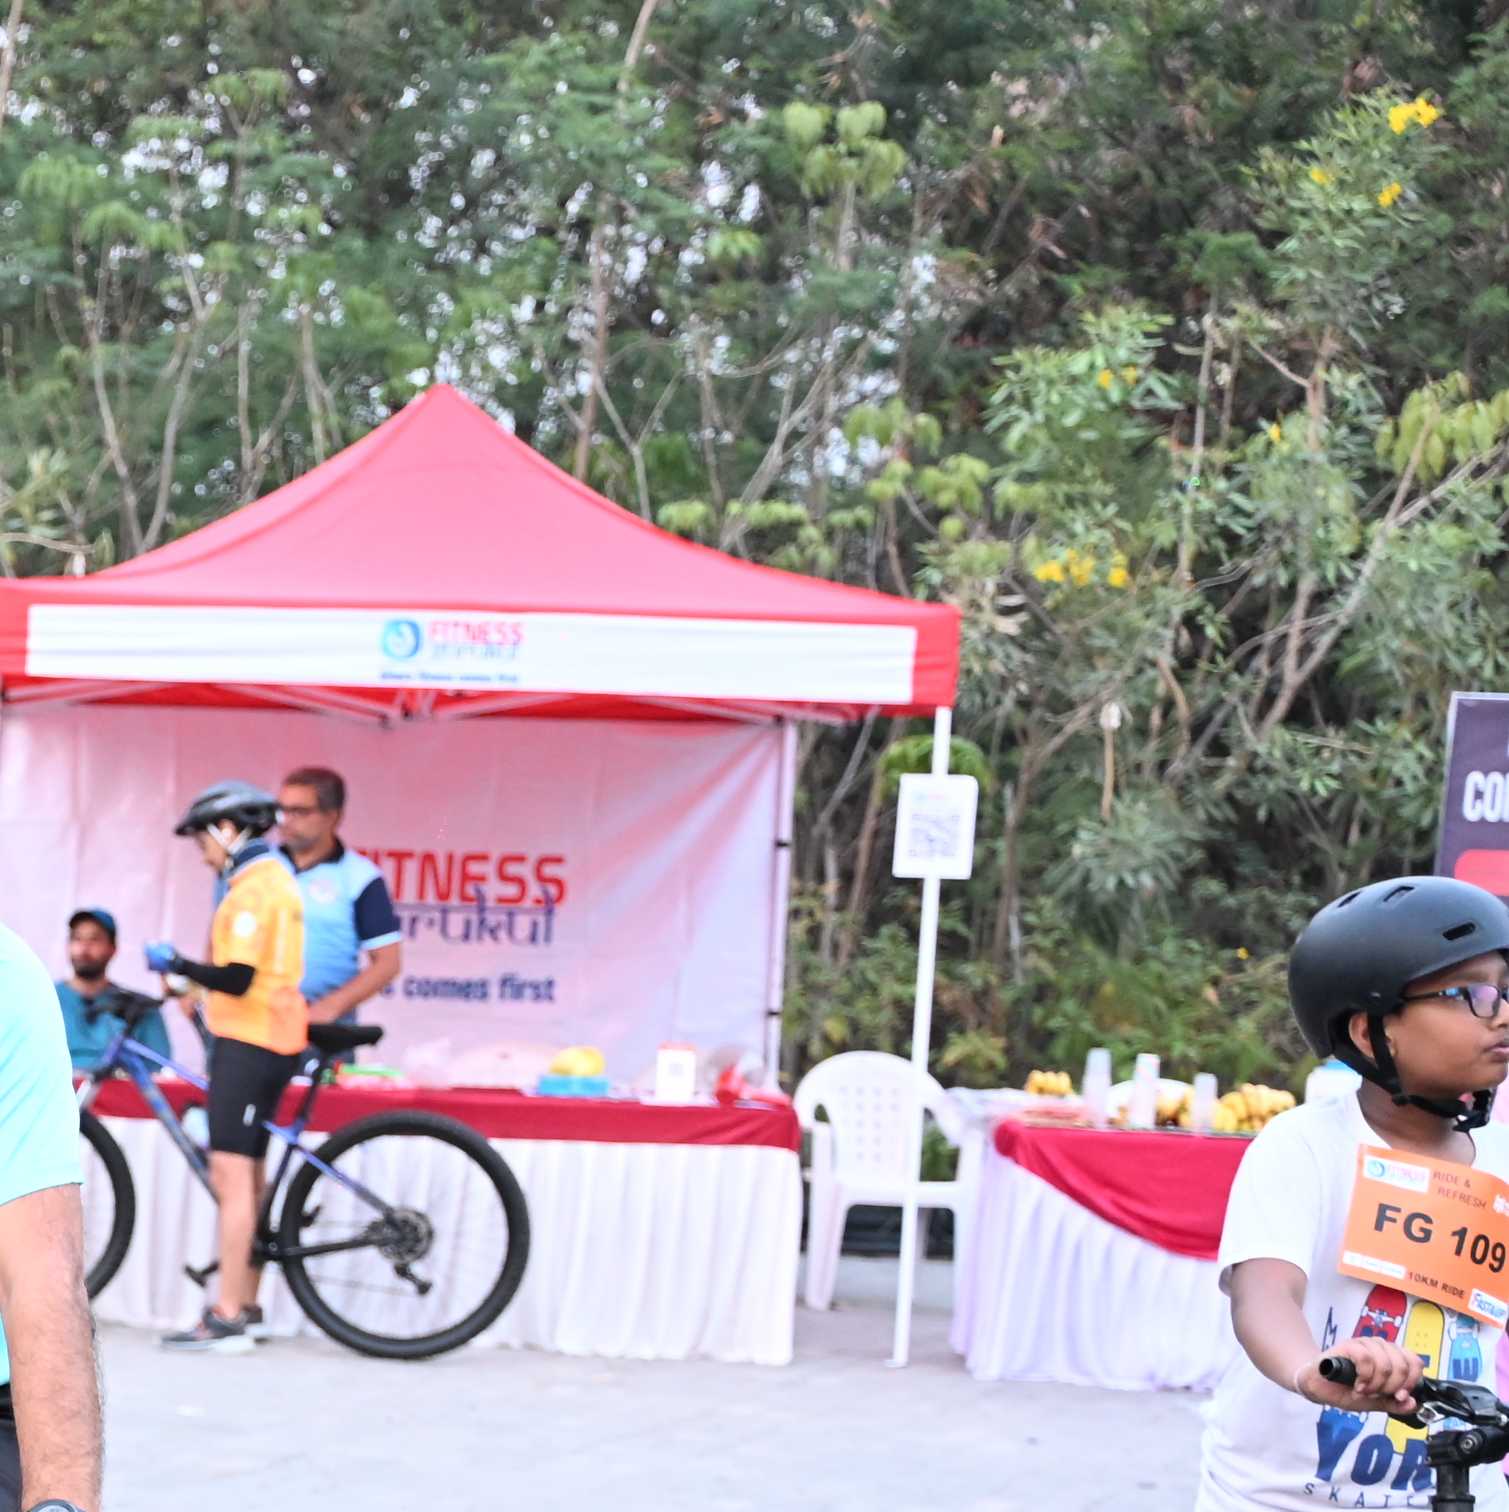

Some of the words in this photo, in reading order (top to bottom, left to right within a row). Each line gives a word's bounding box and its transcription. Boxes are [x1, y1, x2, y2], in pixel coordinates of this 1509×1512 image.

[357, 848, 566, 905] TNESS
[403, 977, 489, 999] comes
[499, 973, 556, 1000] first
[1433, 1170, 1460, 1186] RIDE
[1464, 1178, 1471, 1189] &
[1437, 1186, 1487, 1210] REFRESH
[1374, 1202, 1434, 1244] FG
[1451, 1226, 1507, 1274] 109
[1408, 1271, 1439, 1289] 10KM
[1441, 1282, 1466, 1299] RIDE
[1315, 1422, 1436, 1492] YOR
